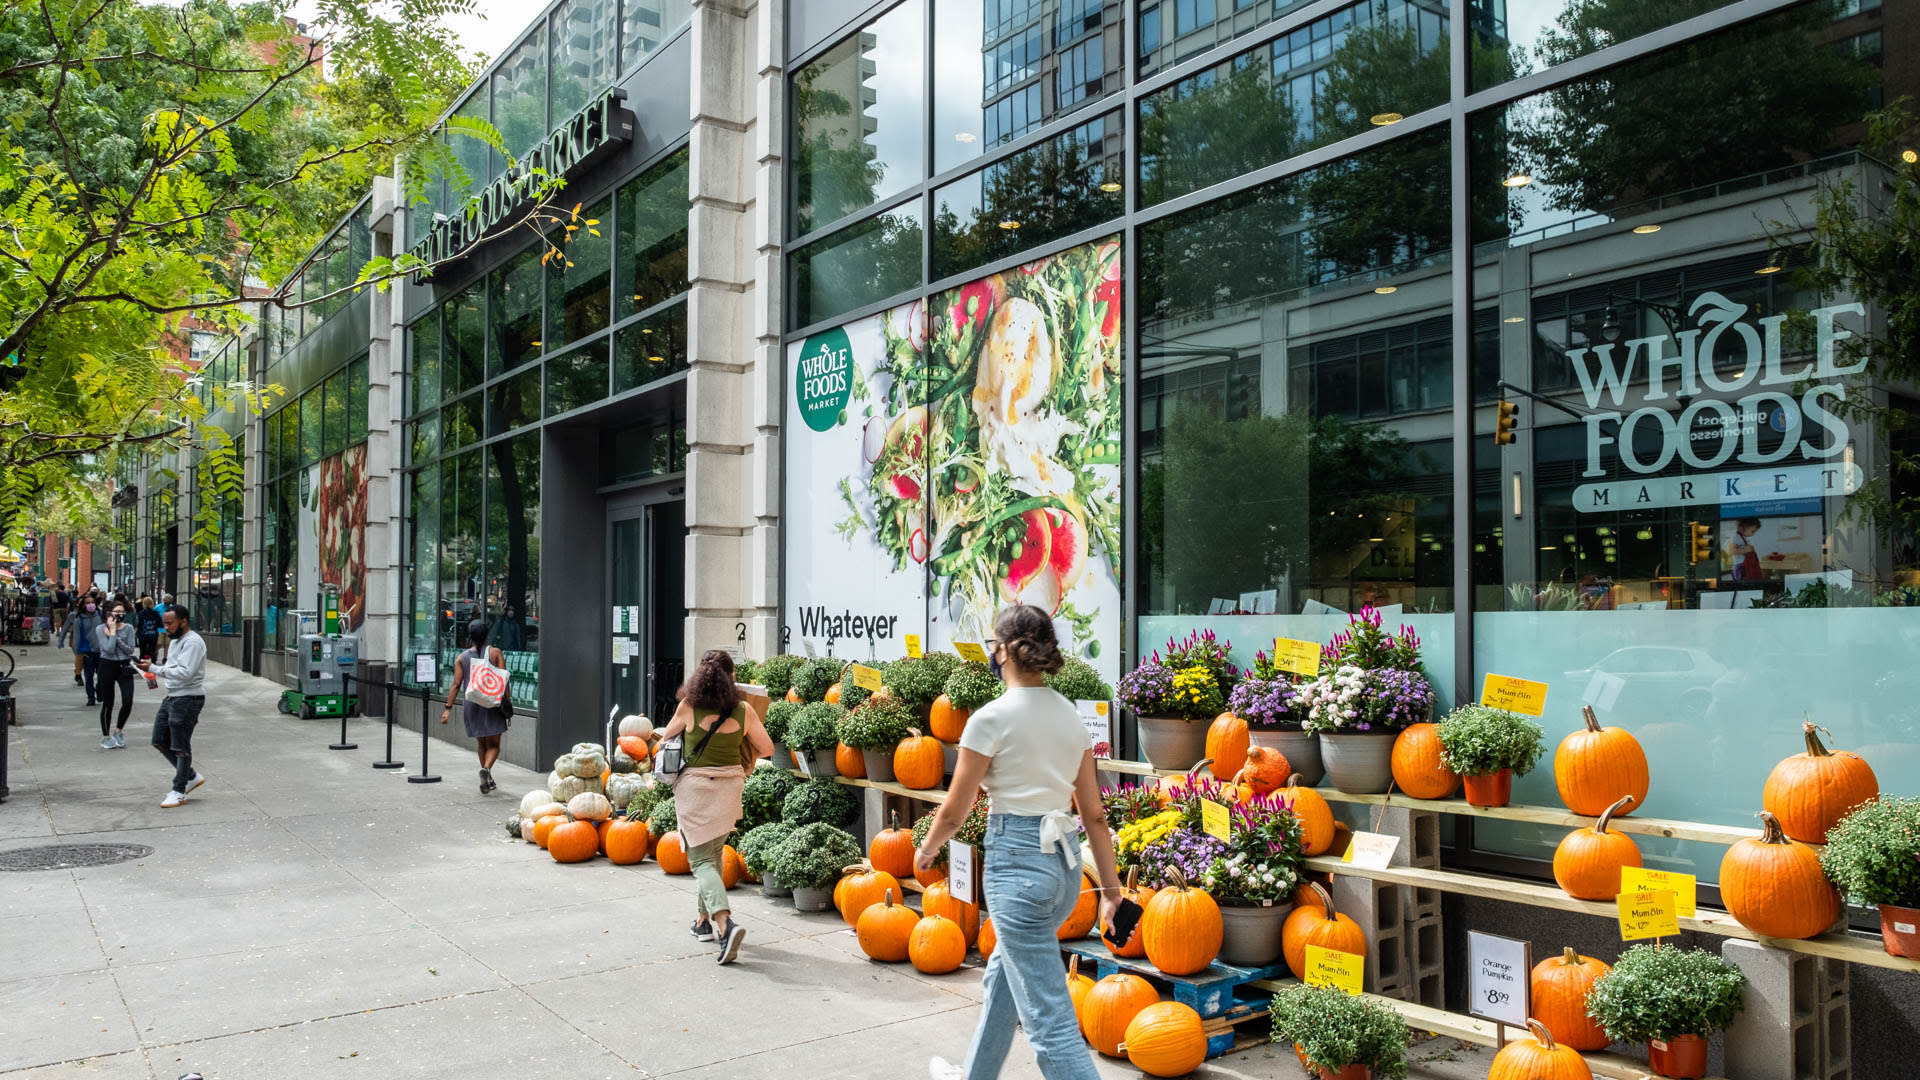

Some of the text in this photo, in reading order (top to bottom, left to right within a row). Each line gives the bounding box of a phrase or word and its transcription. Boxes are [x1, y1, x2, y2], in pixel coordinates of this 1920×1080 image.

[517, 86, 615, 207] MARKET
[1565, 292, 1869, 409] WHOLE
[802, 344, 848, 379] WHOLE
[804, 371, 847, 400] FOODS
[808, 397, 839, 411] MARKET
[1581, 383, 1849, 477] FOODS
[1592, 470, 1838, 506] MARKET
[799, 606, 897, 640] Whatever
[1497, 688, 1516, 697] Mum
[1647, 872, 1669, 880] SALE
[1635, 892, 1653, 901] SALE
[1631, 910, 1650, 919] Mum
[1318, 963, 1335, 974] Mum
[1482, 958, 1512, 973] Orange
[1482, 967, 1514, 982] Pumpkin
